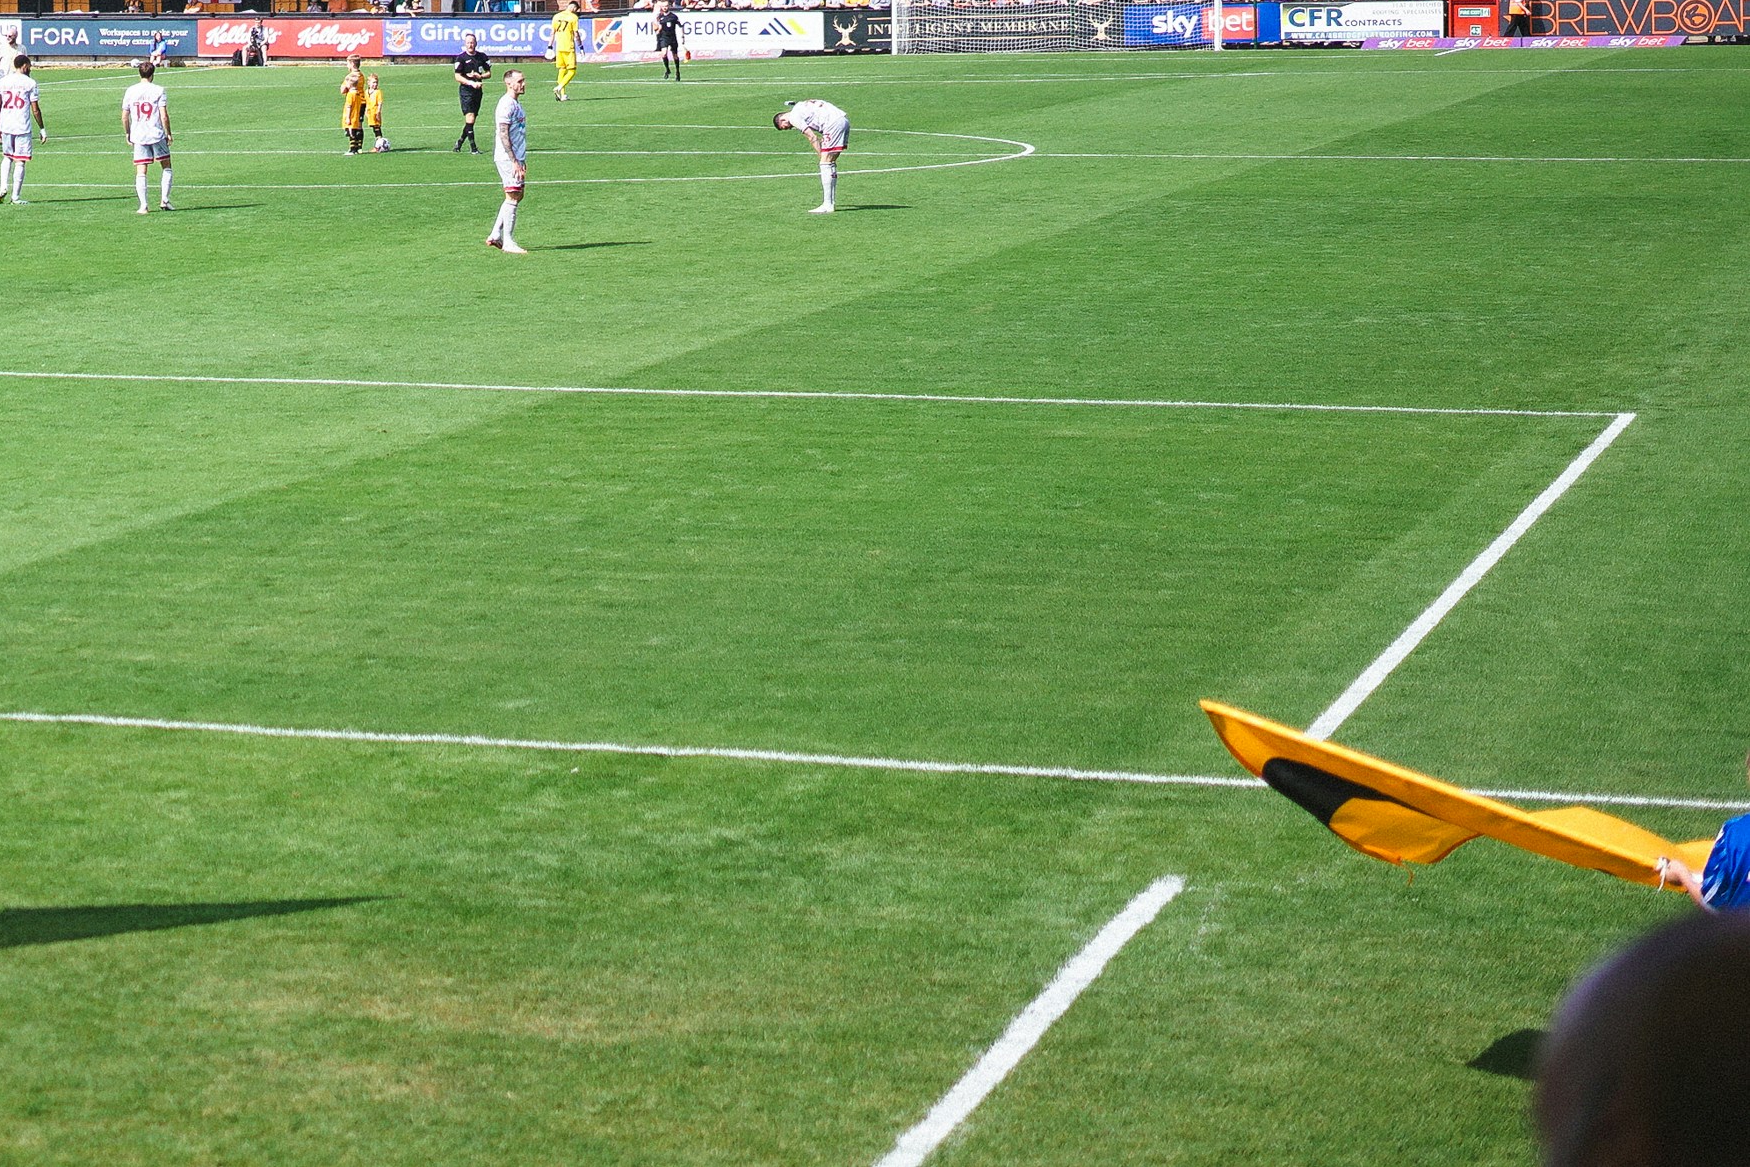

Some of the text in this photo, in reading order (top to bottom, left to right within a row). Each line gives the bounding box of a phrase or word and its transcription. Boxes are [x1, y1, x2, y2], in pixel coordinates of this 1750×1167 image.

[1151, 10, 1199, 38] sky
[1288, 8, 1344, 28] CFR
[1345, 19, 1403, 27] CONTRACTS
[99, 28, 140, 38] Workspaces
[171, 30, 188, 38] your
[490, 22, 536, 41] Golf
[682, 21, 749, 35] GEORGE
[30, 27, 90, 45] FORA
[99, 37, 131, 46] everyday
[297, 23, 372, 52] Kellogg's
[1377, 38, 1431, 48] sky bet
[1454, 37, 1510, 48] sky bet
[1531, 37, 1584, 47] sky bet
[1609, 36, 1662, 46] sky bet
[2, 90, 25, 110] 26
[133, 101, 153, 122] 19
